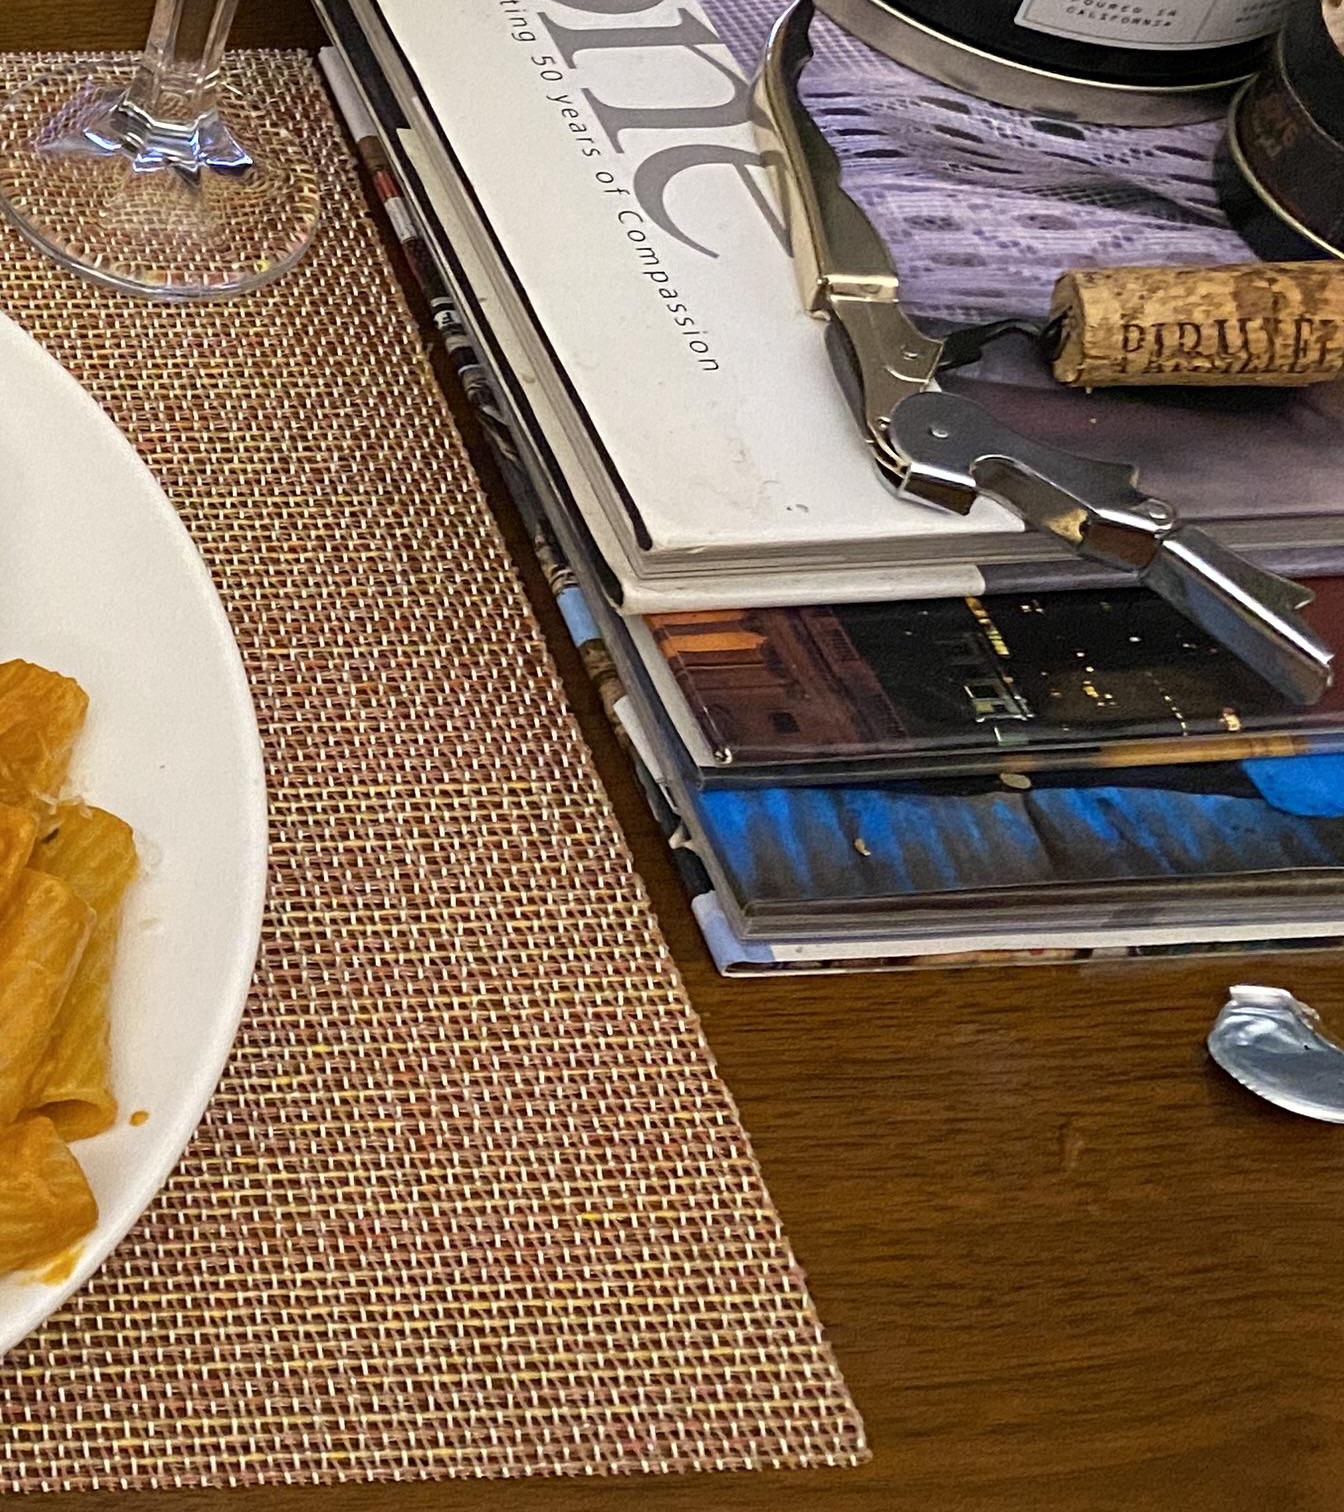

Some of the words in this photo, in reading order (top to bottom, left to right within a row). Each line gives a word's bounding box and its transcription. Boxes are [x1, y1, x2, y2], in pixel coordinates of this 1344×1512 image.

[1065, 6, 1173, 28] CALIFORNIA
[530, 55, 564, 82] 50
[546, 93, 602, 158] years
[595, 170, 631, 197] of
